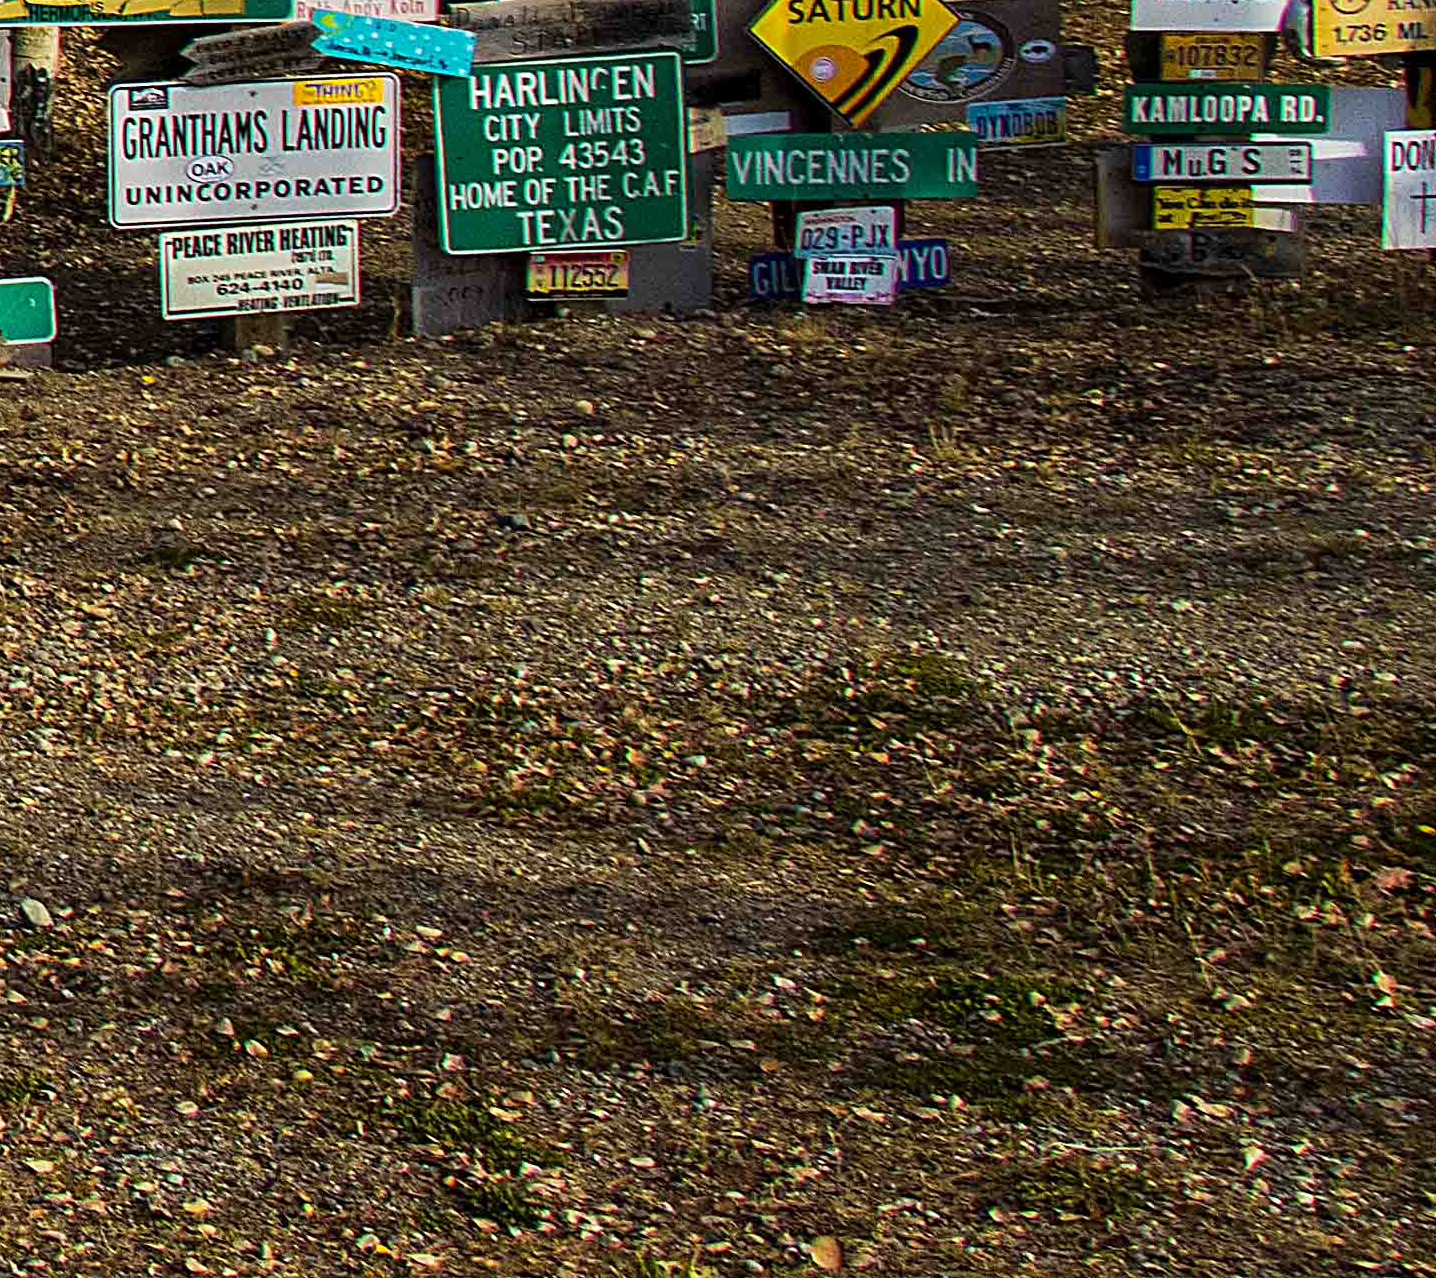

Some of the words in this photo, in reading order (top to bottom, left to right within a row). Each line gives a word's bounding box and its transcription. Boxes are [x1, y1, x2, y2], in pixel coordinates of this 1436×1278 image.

[483, 116, 540, 142] CITY
[565, 107, 642, 137] LIMITS
[1131, 96, 1269, 123] KAMLOOPA
[1284, 96, 1325, 123] RD.
[122, 110, 268, 161] GRANTHAMS
[281, 106, 387, 152] LANDING
[494, 148, 545, 173] POP.
[559, 141, 646, 168] 43543
[125, 176, 384, 207] UNINCORPORATED
[172, 234, 223, 258] PEACE
[227, 231, 274, 255] RIVER
[279, 226, 348, 252] HEATING
[515, 207, 625, 246] TEXAS
